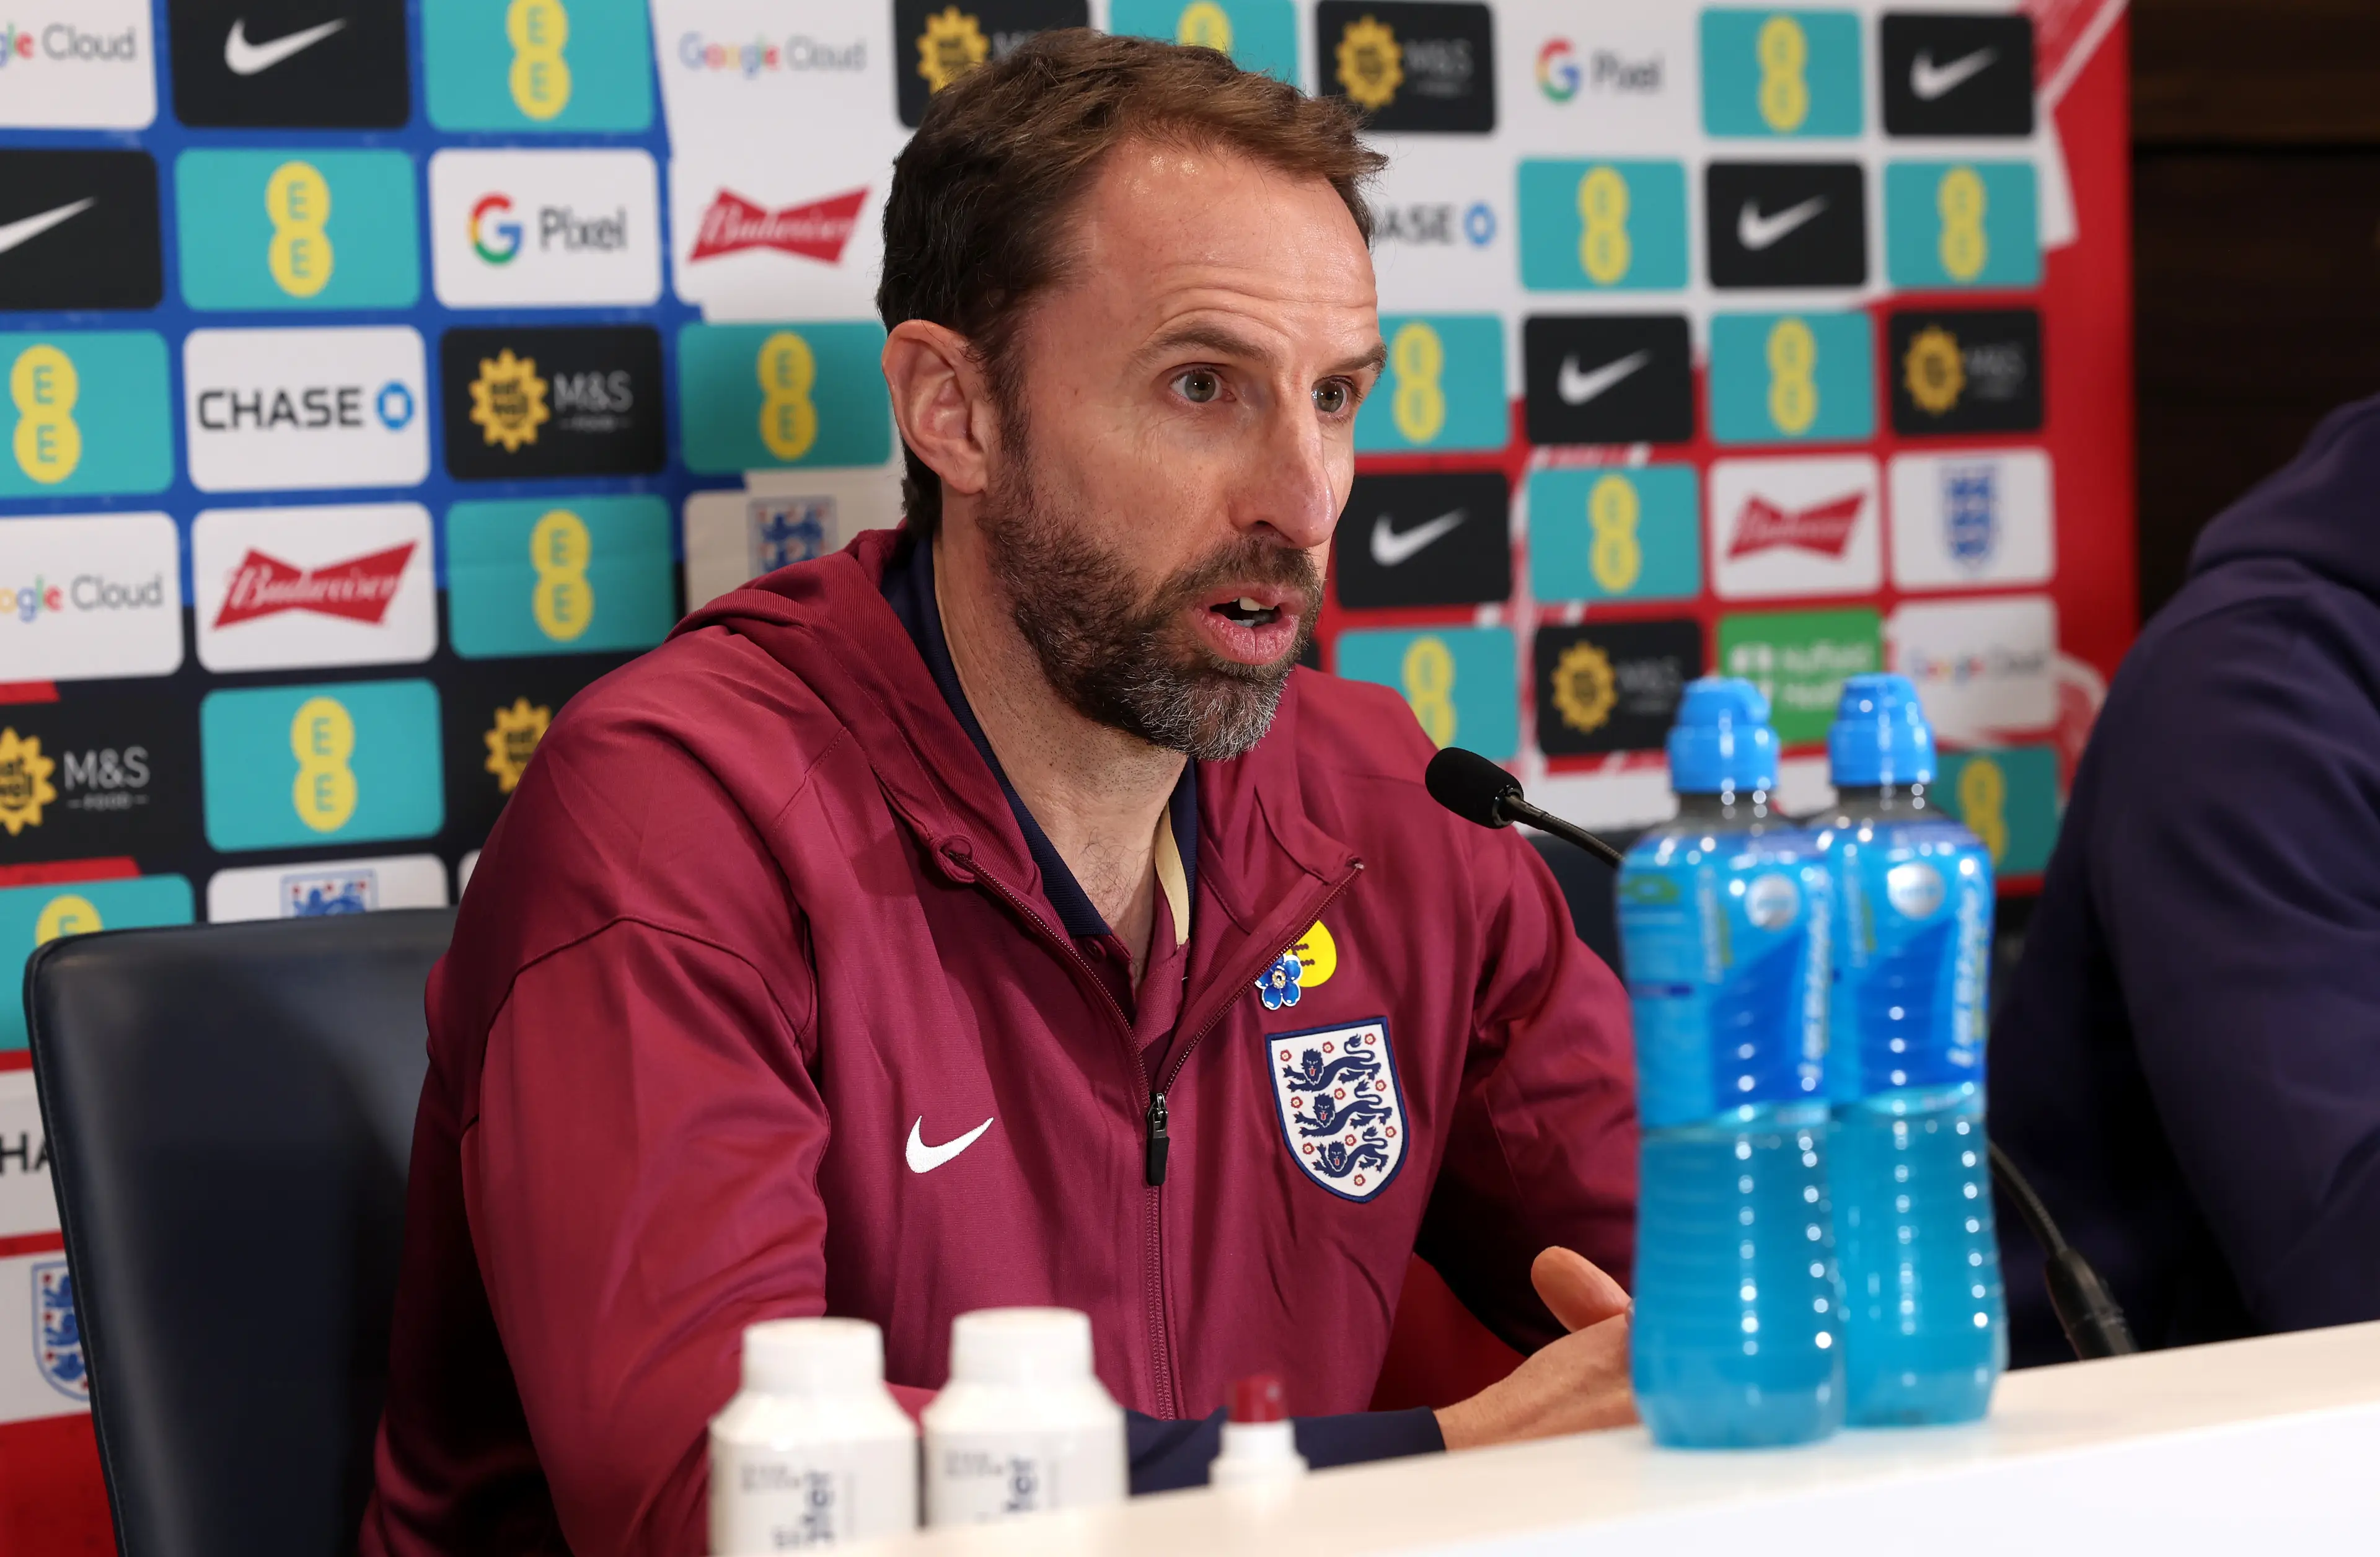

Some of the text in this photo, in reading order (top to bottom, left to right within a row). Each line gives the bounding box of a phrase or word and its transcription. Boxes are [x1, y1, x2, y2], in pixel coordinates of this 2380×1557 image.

[41, 22, 136, 62] Cloud
[539, 206, 627, 251] Pixel
[1375, 202, 1457, 245] ASE
[198, 387, 363, 431] CHASE
[0, 571, 164, 624] ogle Cloud
[63, 746, 150, 791] M&S
